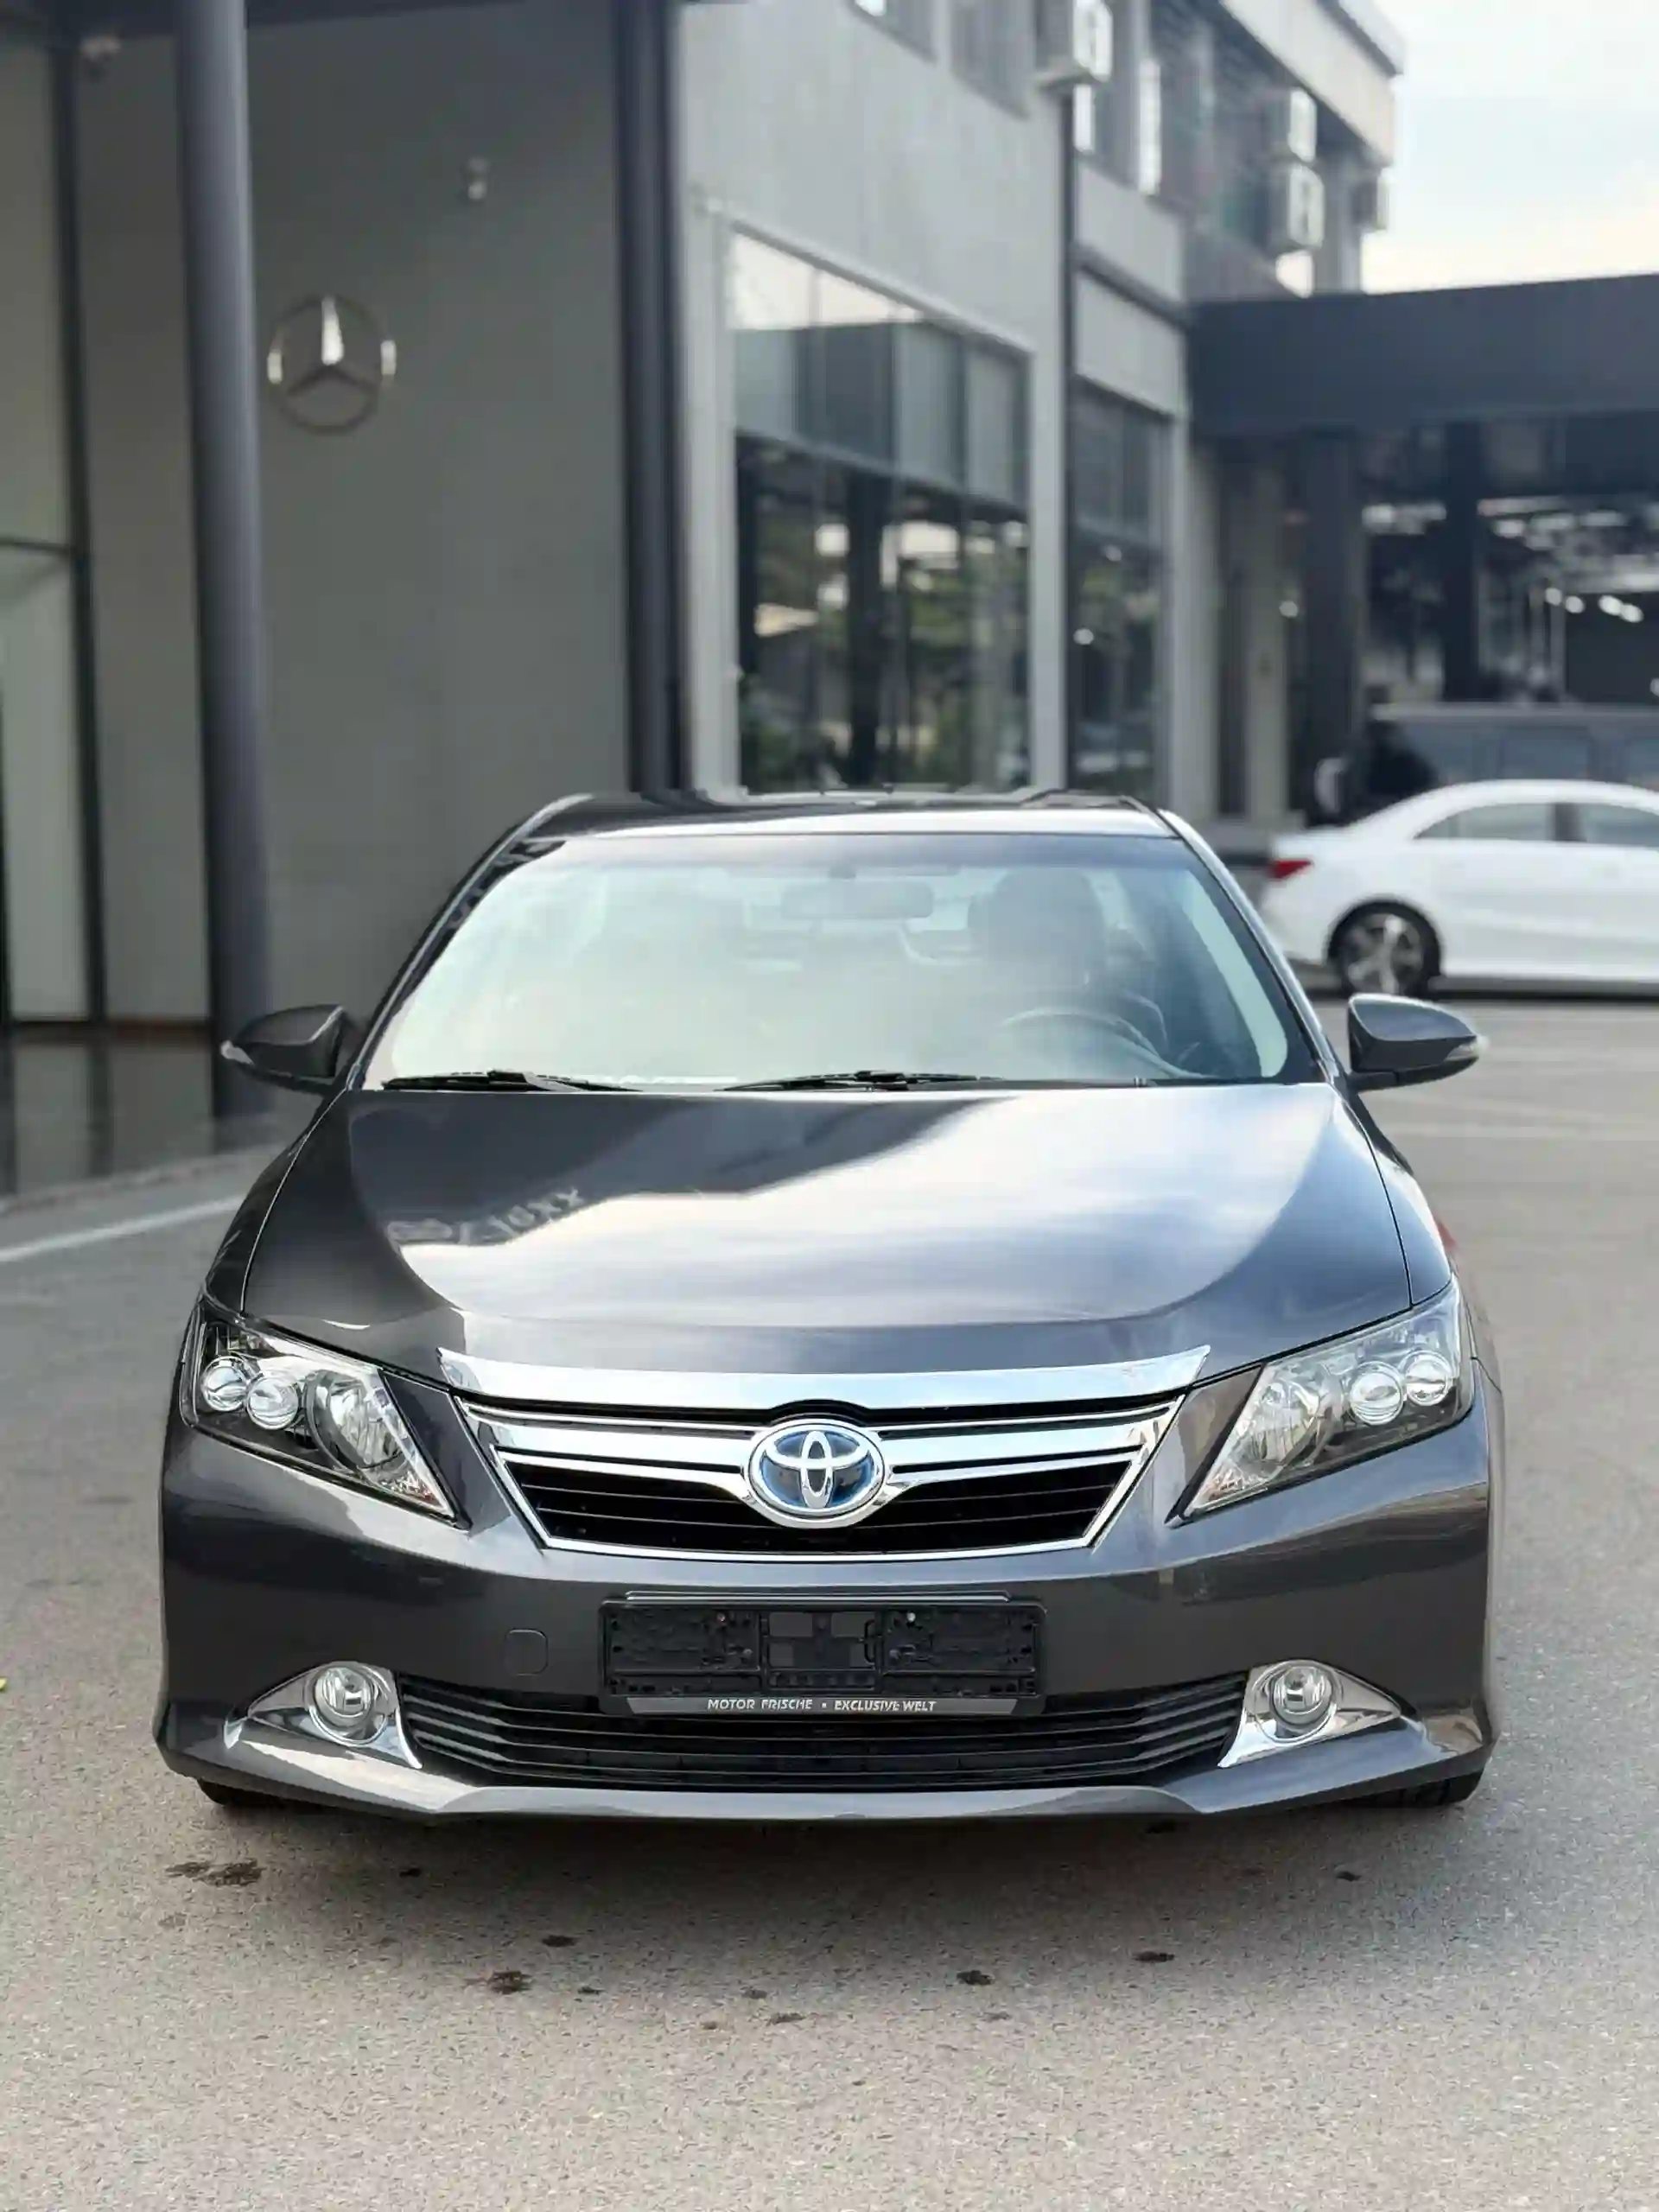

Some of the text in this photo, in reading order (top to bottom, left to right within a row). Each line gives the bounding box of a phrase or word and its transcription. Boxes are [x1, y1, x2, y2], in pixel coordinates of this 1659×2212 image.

[708, 1699, 938, 1712] MOTOR FRISCHE EXCLUSIVE WELT
